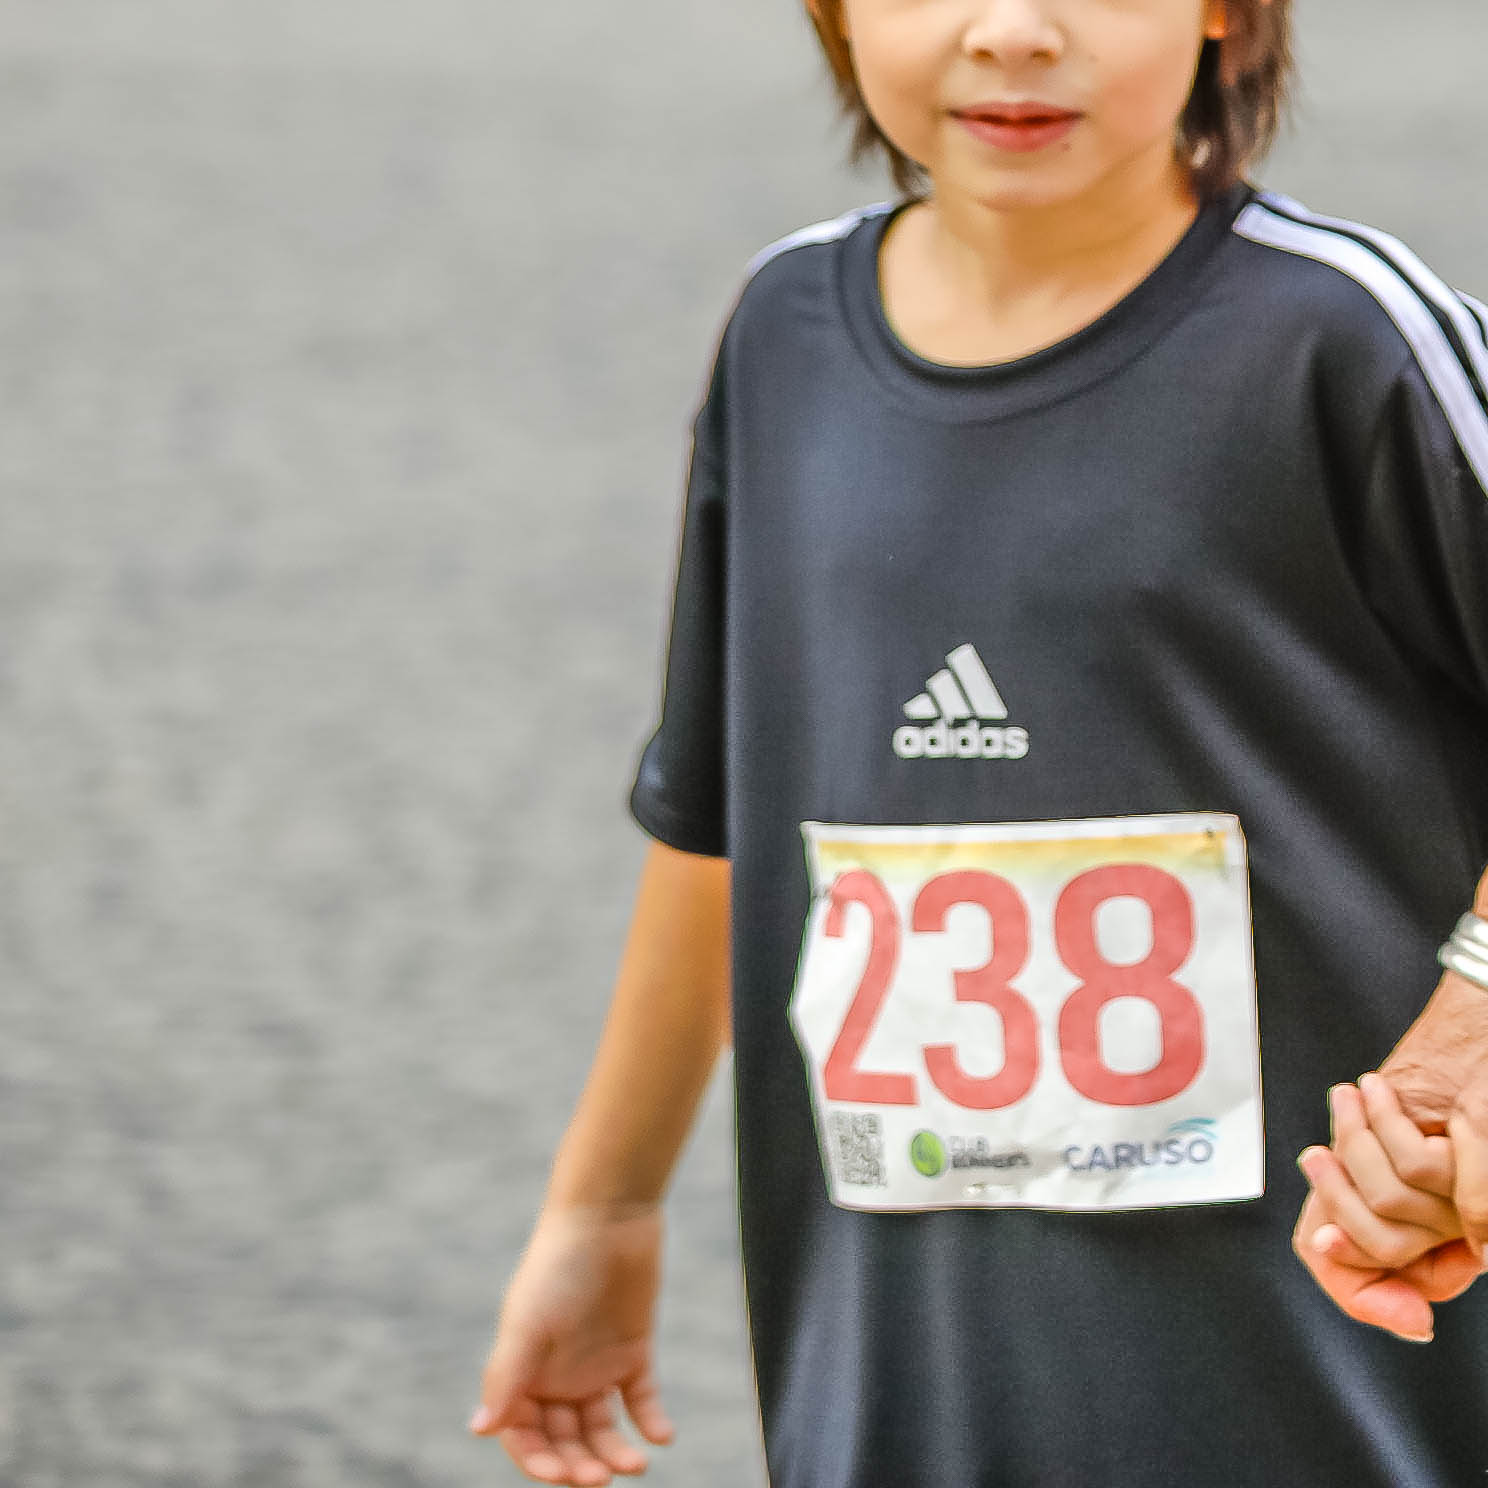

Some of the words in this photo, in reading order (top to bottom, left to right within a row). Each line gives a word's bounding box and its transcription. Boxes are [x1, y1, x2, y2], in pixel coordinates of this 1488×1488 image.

[892, 719, 1030, 759] adidas
[822, 862, 1207, 1111] 238
[1063, 1138, 1214, 1171] CARUSO
